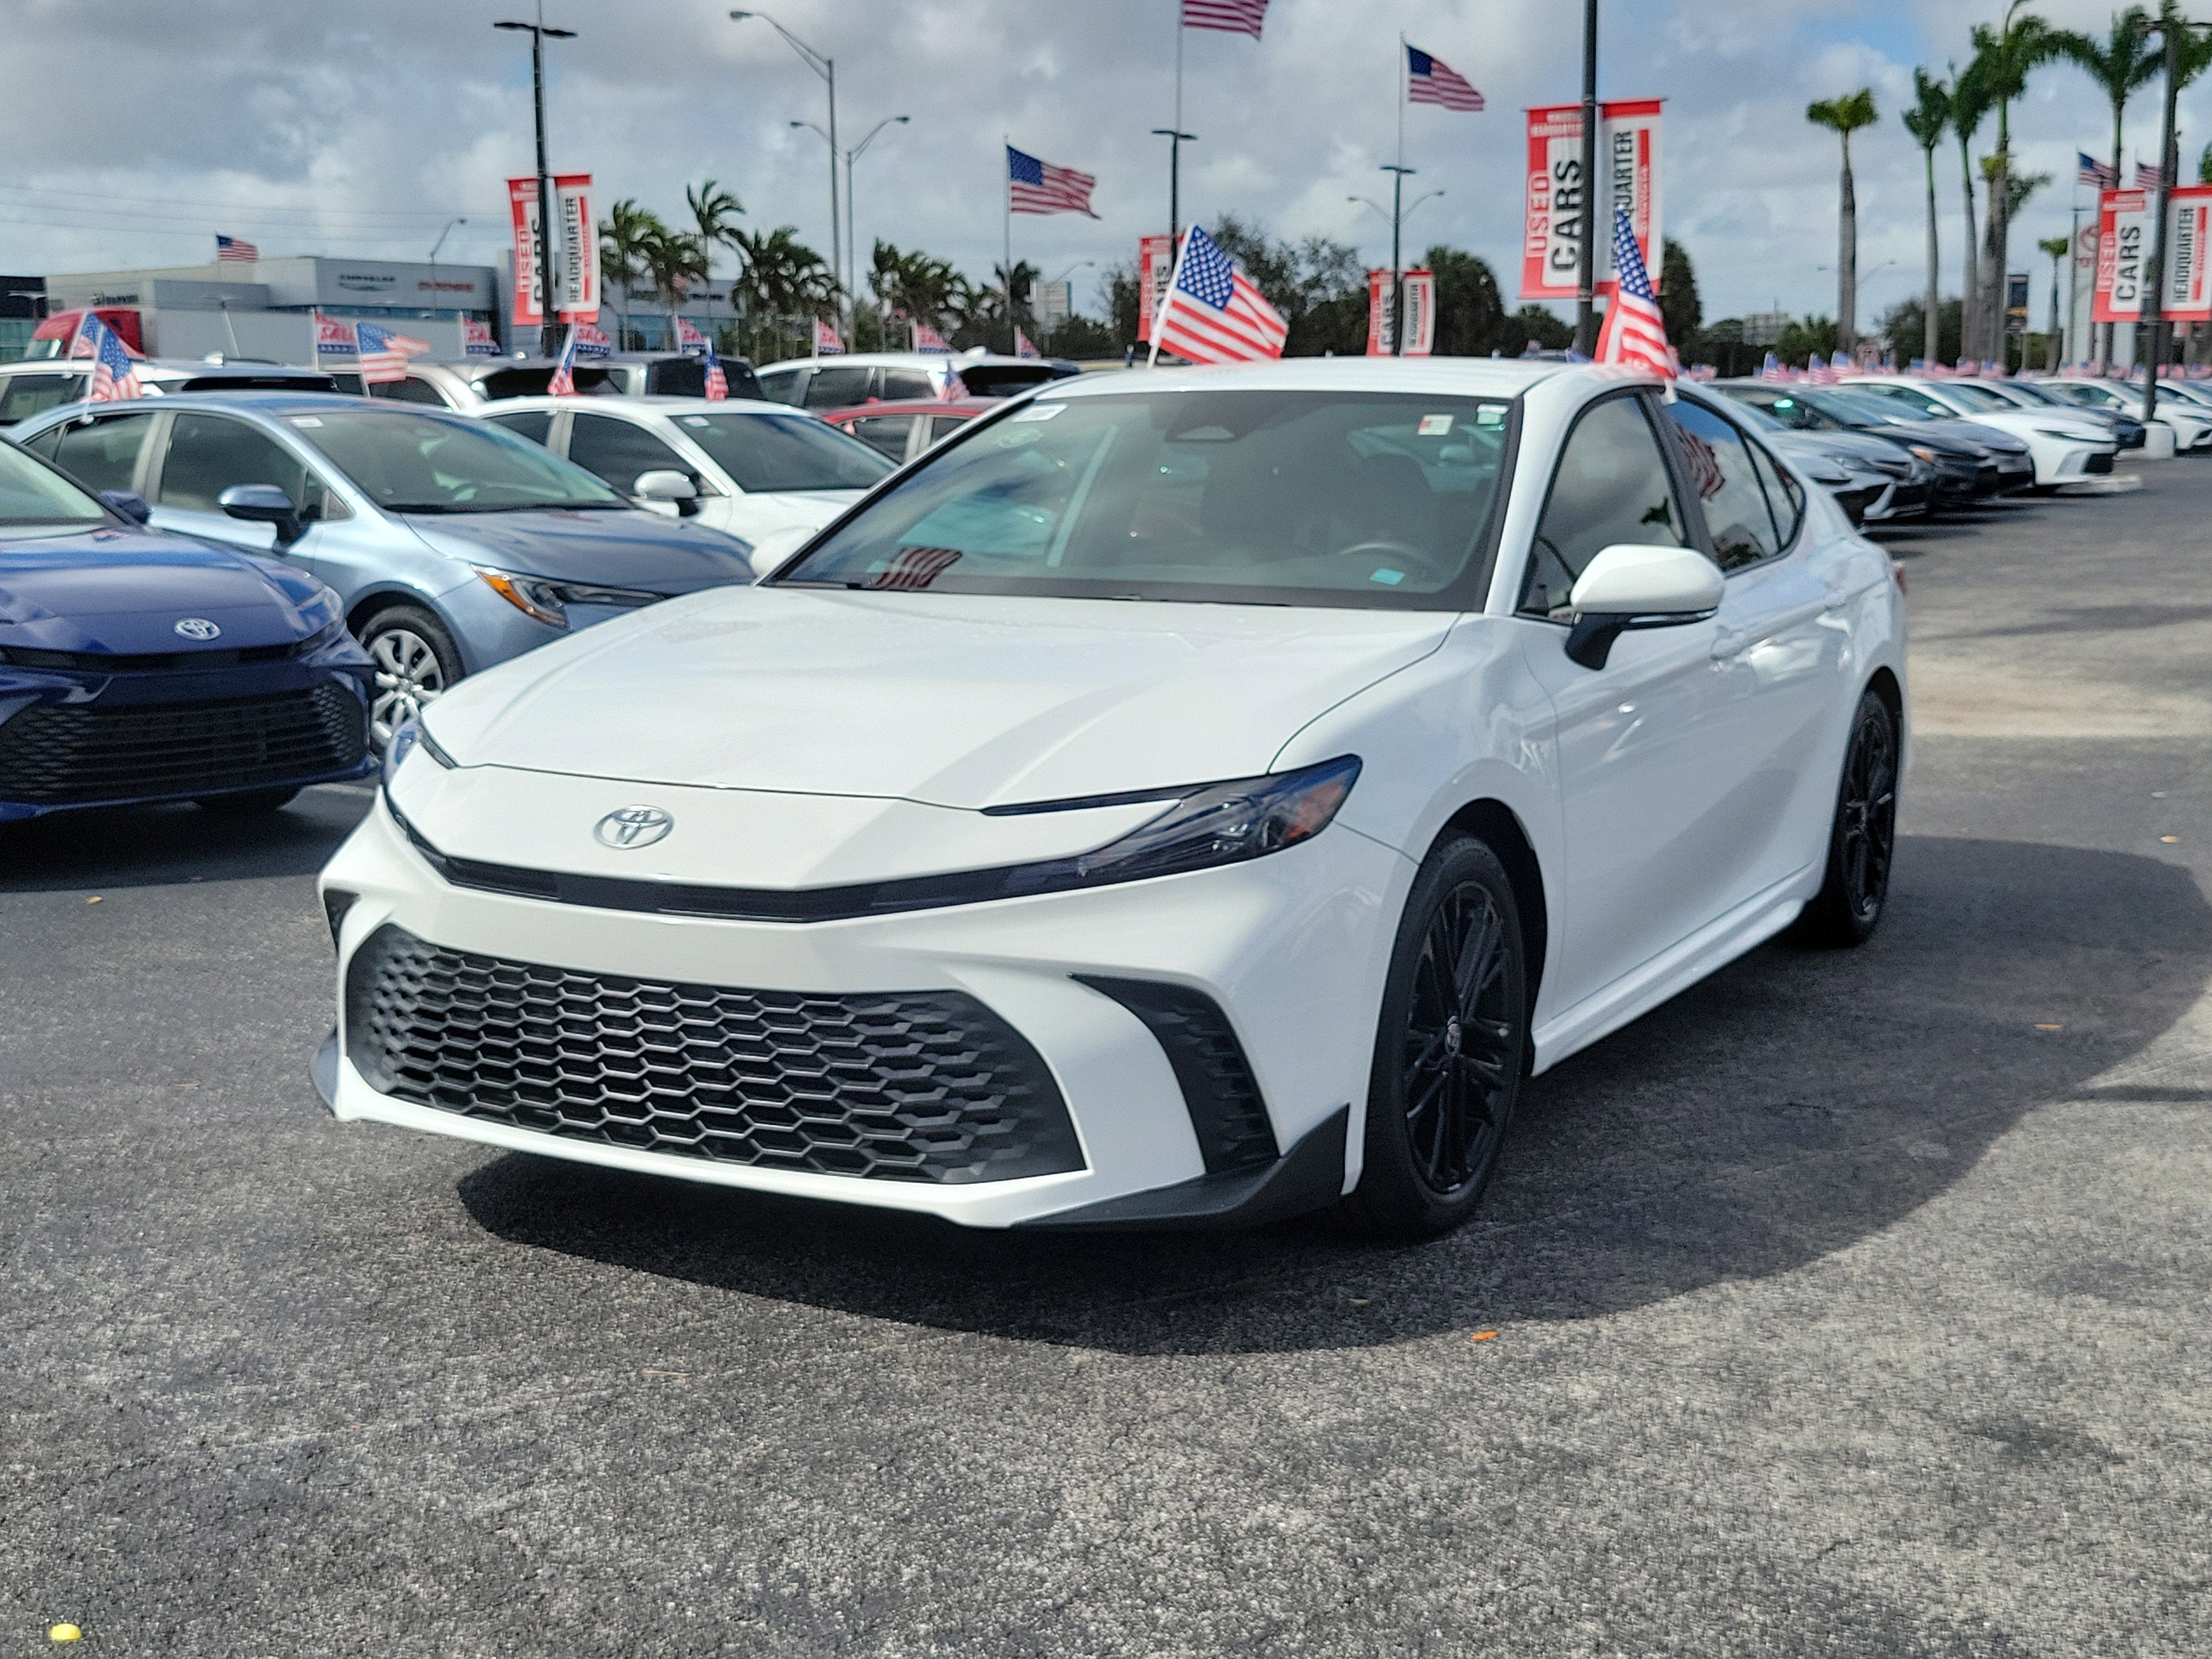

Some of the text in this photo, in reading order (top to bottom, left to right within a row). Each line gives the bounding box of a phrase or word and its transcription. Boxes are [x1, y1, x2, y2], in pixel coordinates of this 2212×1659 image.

[1528, 174, 1549, 254] USED
[1551, 160, 1583, 270] CARS
[518, 229, 532, 290] USED
[2097, 235, 2115, 291] USED
[2116, 226, 2141, 300] CARS
